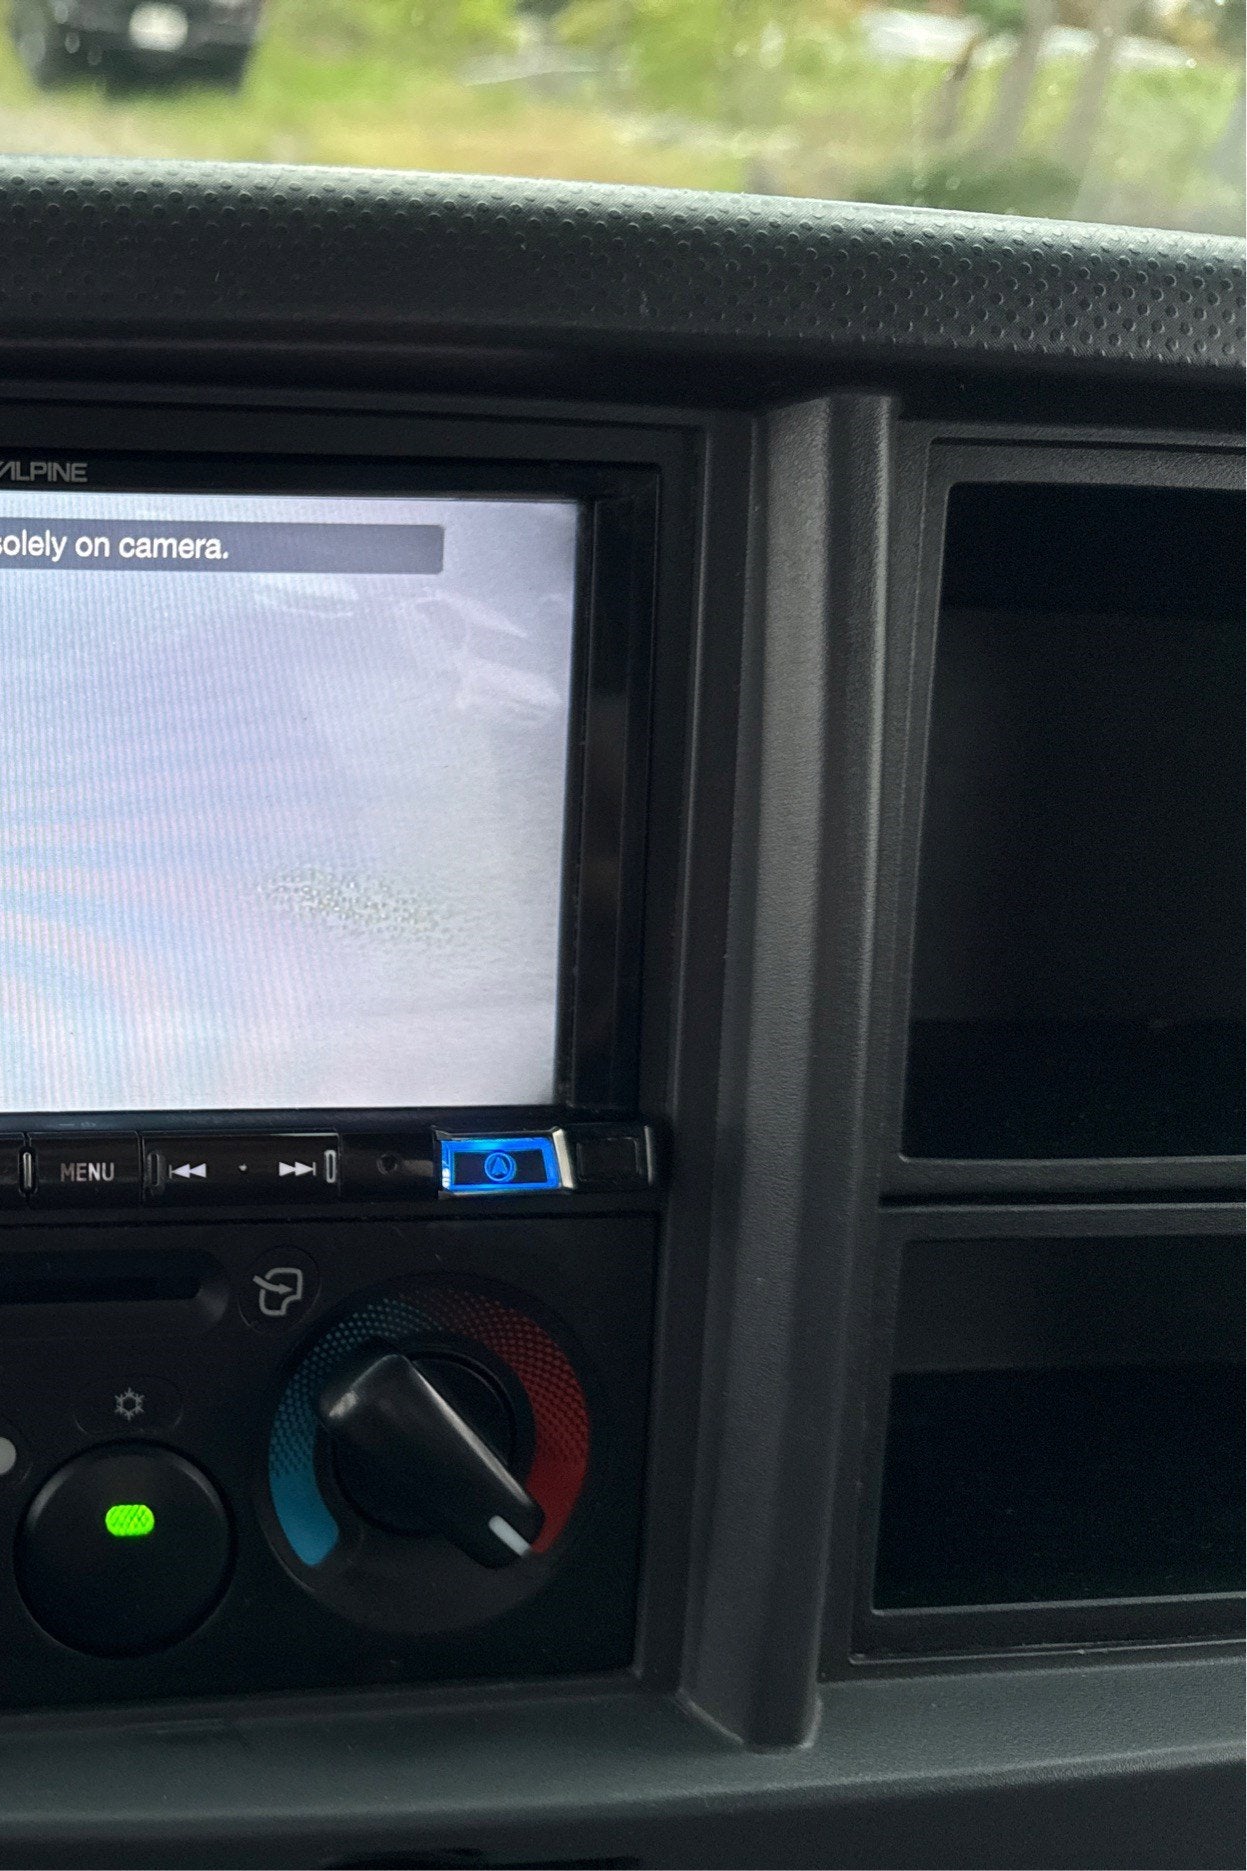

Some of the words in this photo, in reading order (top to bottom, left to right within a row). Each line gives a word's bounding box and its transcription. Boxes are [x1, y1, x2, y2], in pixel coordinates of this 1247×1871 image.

[74, 536, 111, 558] on
[118, 536, 229, 560] camera.
[60, 1161, 115, 1182] MENU
